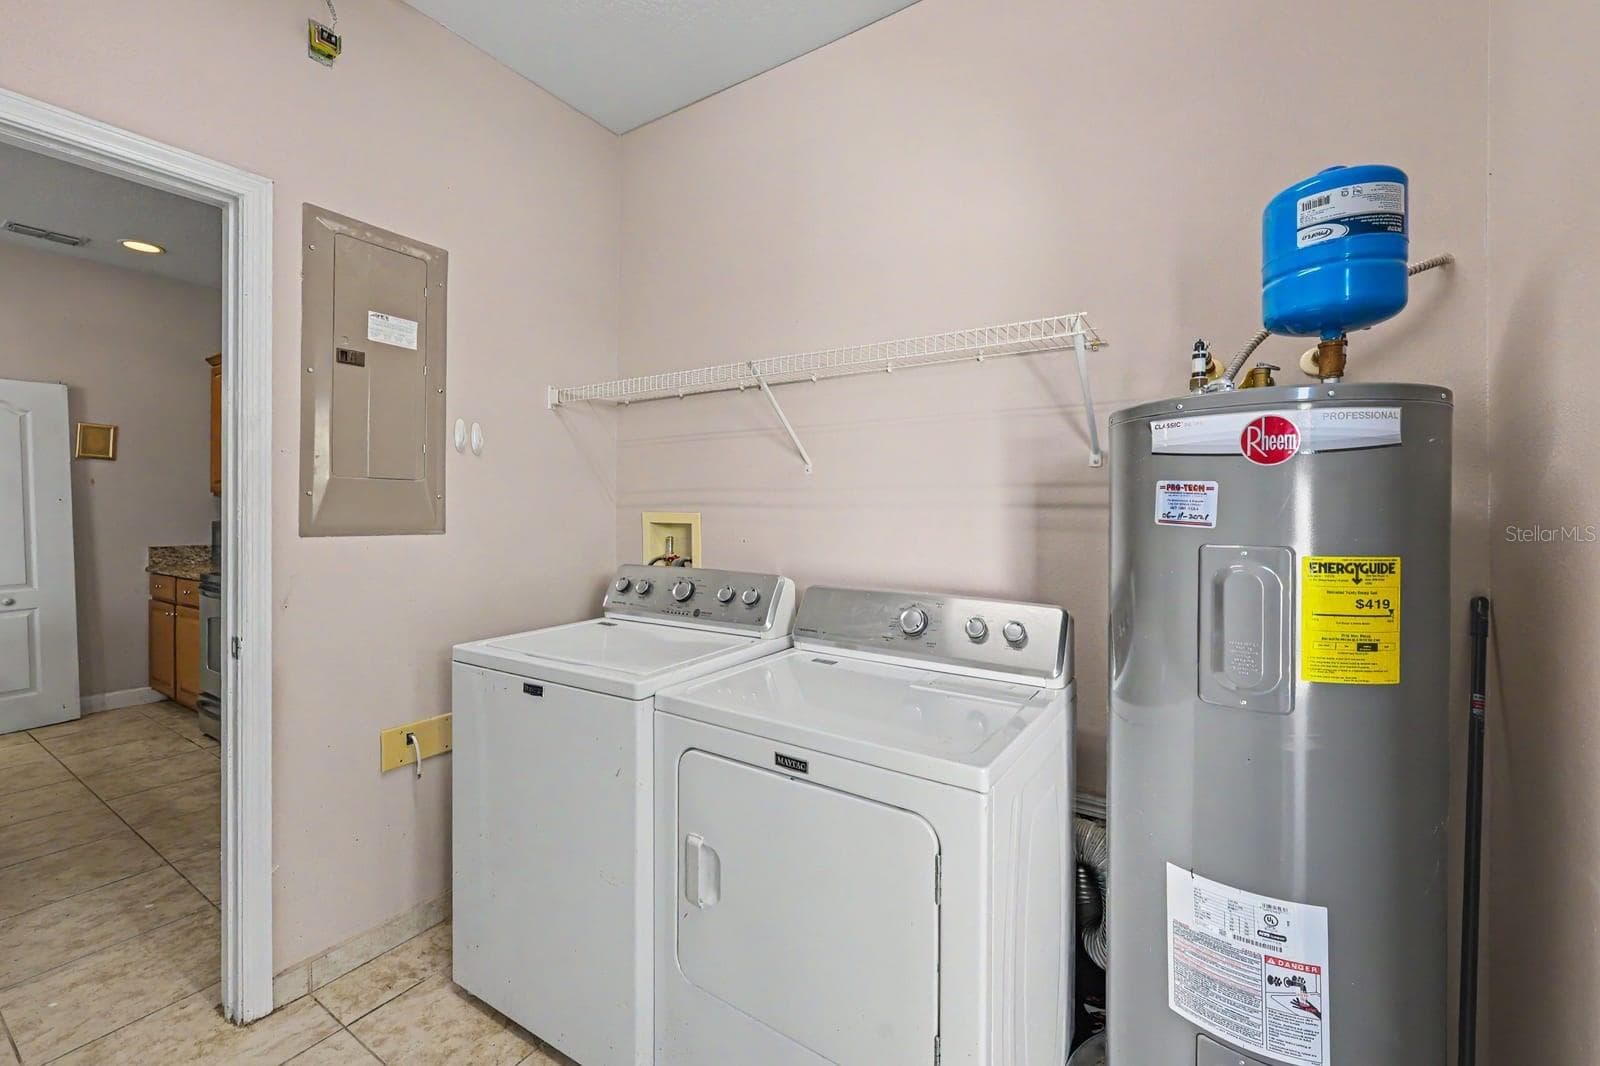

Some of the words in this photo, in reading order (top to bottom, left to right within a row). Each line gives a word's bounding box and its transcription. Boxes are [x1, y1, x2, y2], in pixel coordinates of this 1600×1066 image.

[1322, 411, 1399, 421] PROFESSIONAL
[1246, 416, 1298, 458] Rheem
[1309, 562, 1396, 575] ENERGYGUIDE
[1355, 598, 1391, 610] $419
[776, 756, 807, 770] MAYTAG
[1278, 959, 1319, 974] DANGER
